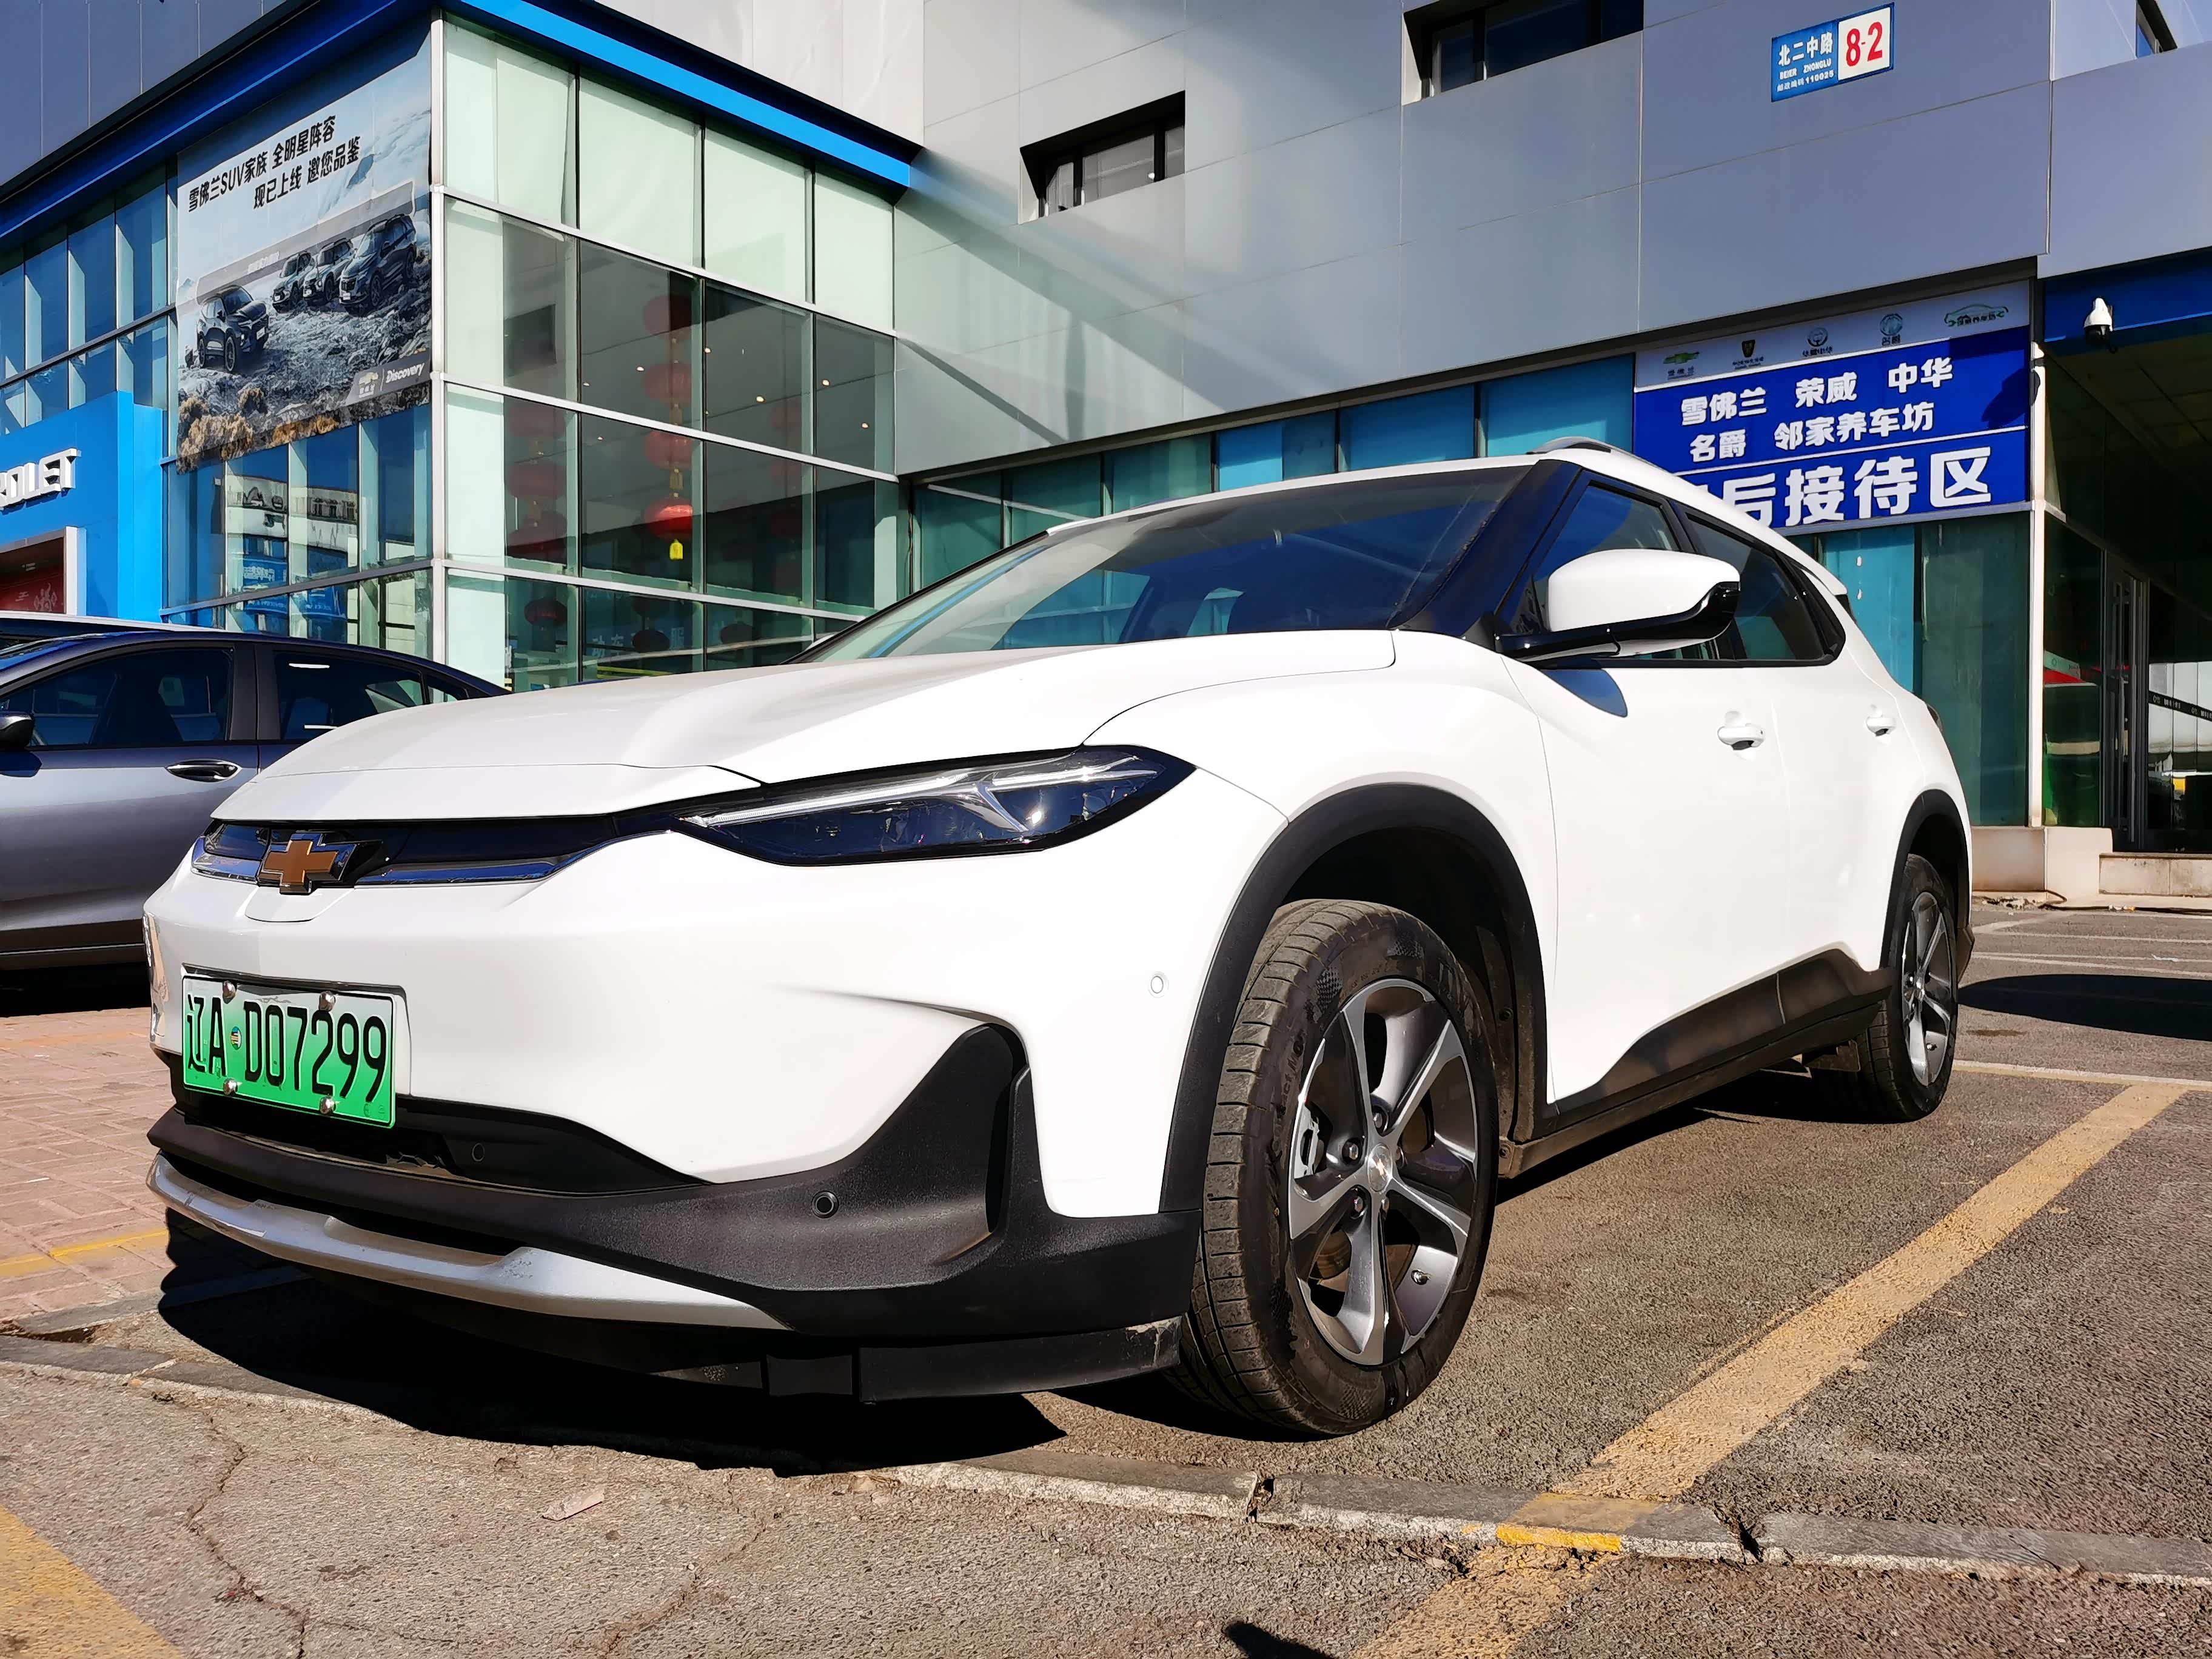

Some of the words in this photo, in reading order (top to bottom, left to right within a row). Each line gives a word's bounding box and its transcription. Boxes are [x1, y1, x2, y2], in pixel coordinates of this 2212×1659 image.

[1778, 32, 1834, 67] 北二中路
[1846, 21, 1883, 67] 8-2
[189, 151, 268, 212] 雪佛兰SUV家族
[272, 115, 337, 170] 全明星阵容
[253, 164, 303, 209] 现已上线
[307, 135, 361, 185] 邀您品鉴
[1680, 386, 1767, 426] 雪佛兰
[1795, 371, 1857, 408] 荣威
[1888, 357, 1954, 394] 中华
[1689, 428, 1746, 463] 名爵
[1774, 401, 1936, 451] 邻家养车坊
[1696, 446, 1992, 529] 后接待区
